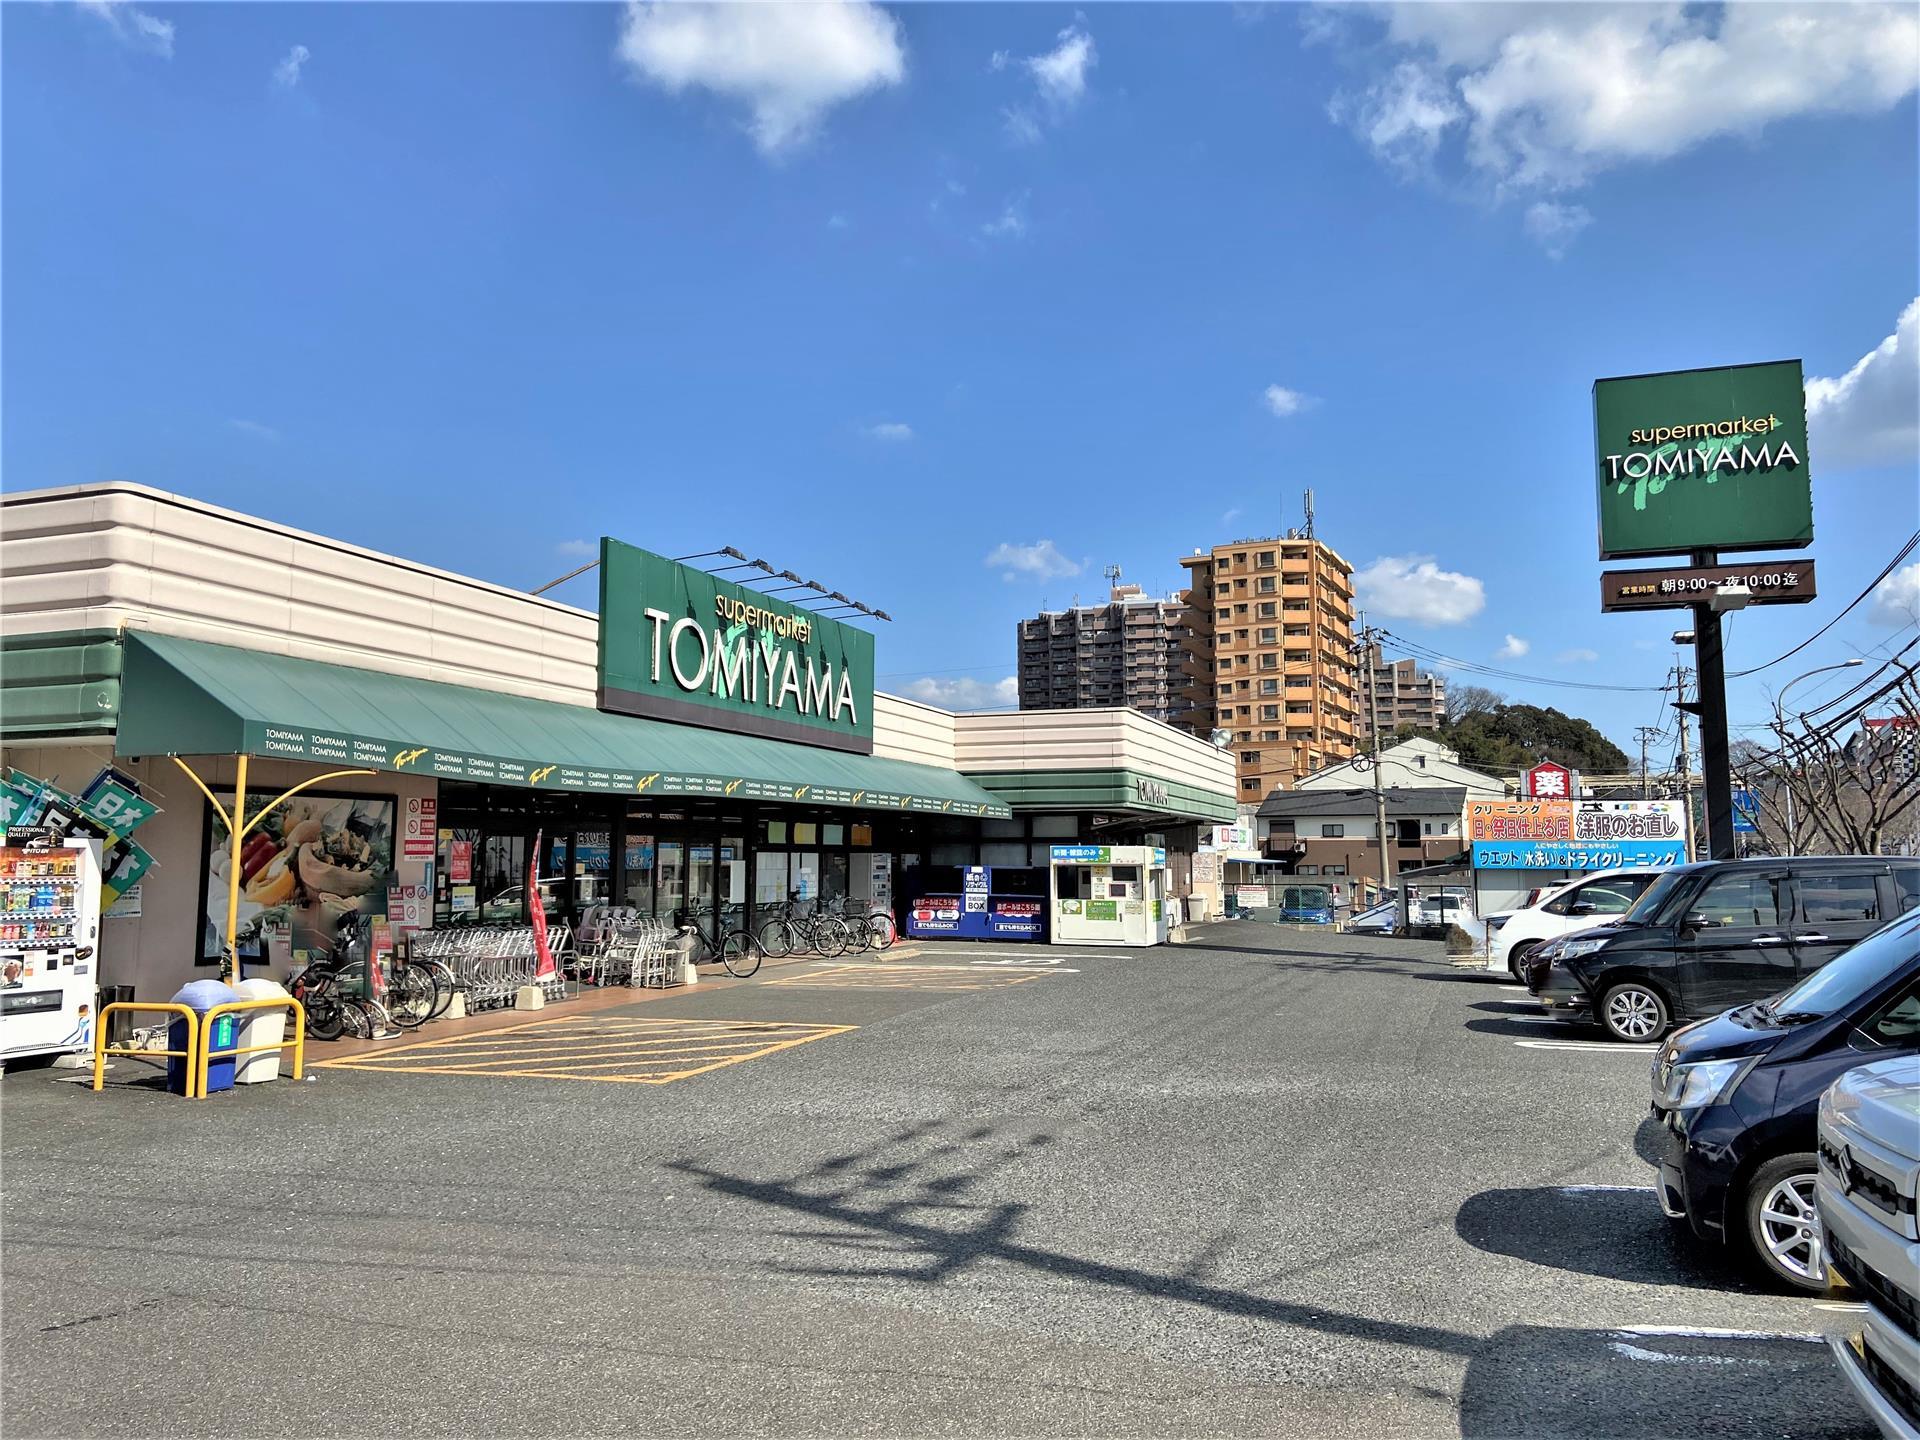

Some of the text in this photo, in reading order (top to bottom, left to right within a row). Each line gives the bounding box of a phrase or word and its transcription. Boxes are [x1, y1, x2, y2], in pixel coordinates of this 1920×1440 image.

[1631, 414, 1777, 445] supermarket
[1606, 441, 1800, 479] TOMIYAMA
[715, 594, 812, 644] supermarket
[644, 607, 857, 725] TOMIYAMA
[265, 741, 303, 753] TOMIYAMA
[311, 746, 346, 758] TOMIYAMA
[353, 752, 386, 763] TOMIYAMA
[266, 729, 386, 752] TOMIYAMA TOMIYAMA TOMIYAMA
[434, 753, 463, 764] TOMIYAMA
[468, 758, 495, 768] TOMIYAMA
[499, 762, 525, 772] TOMIYAMA
[434, 763, 463, 774] TOMIYAMA
[467, 768, 494, 777] TOMIYAMA
[498, 772, 524, 781] TOMIYAMA
[1535, 771, 1565, 796] 薬
[1474, 804, 1541, 815] クリーニング
[1576, 812, 1679, 840] 洋服のお直し
[968, 902, 985, 910] BOX
